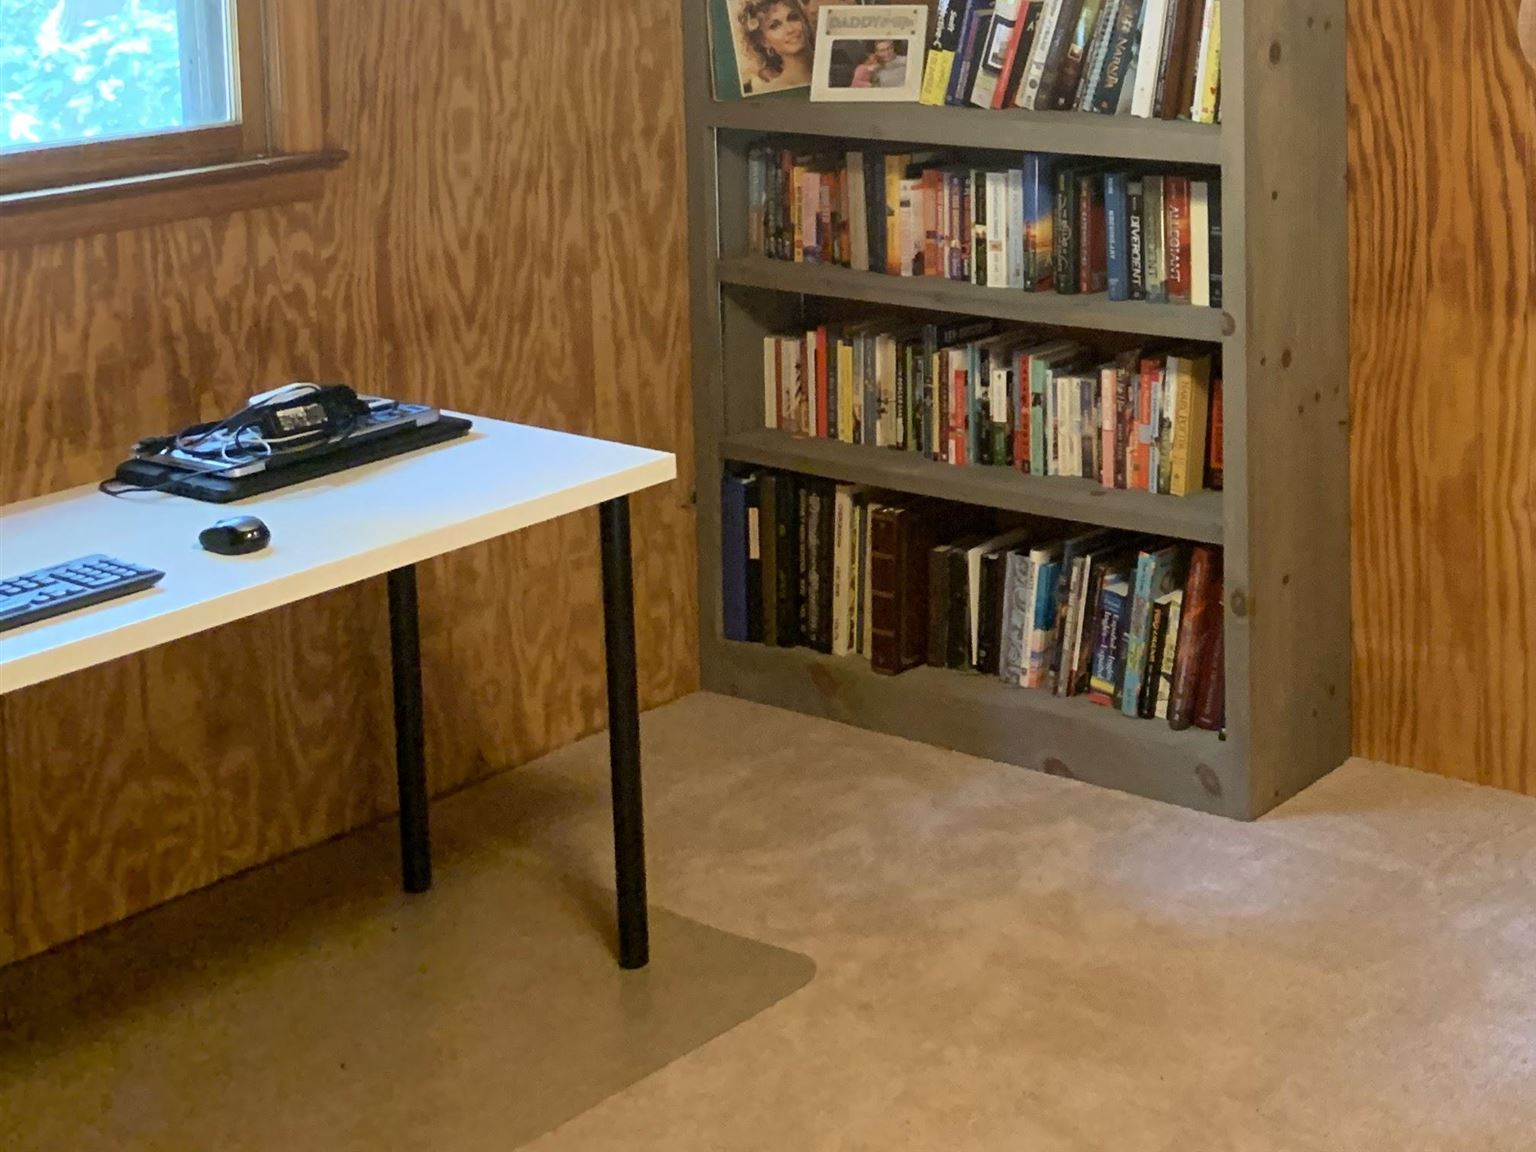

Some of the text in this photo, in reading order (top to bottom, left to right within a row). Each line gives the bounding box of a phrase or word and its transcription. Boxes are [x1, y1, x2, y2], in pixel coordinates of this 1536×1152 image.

[827, 15, 882, 31] DADDY
[1103, 36, 1128, 88] NARNIA
[1129, 215, 1141, 286] DIVERGENT
[1167, 204, 1180, 282] ALLEGIANT
